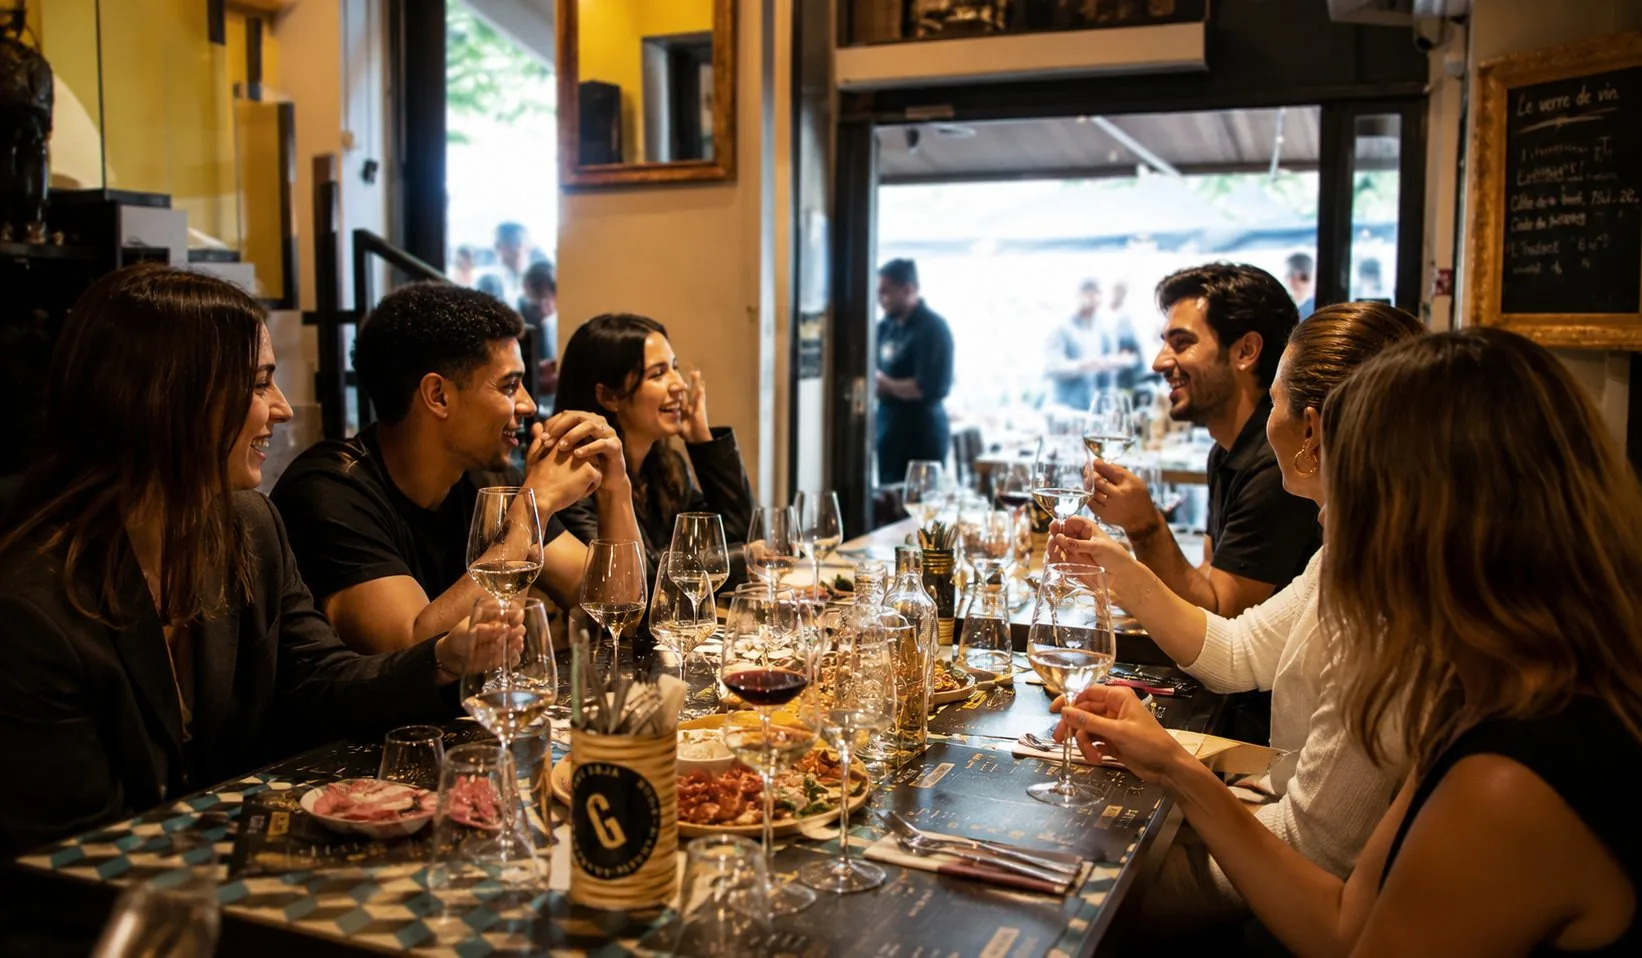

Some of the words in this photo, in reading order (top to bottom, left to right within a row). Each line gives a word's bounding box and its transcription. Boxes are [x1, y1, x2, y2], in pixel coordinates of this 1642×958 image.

[1516, 91, 1534, 117] Le
[1539, 95, 1571, 112] verre
[1576, 83, 1592, 106] de
[1598, 81, 1619, 102] vin
[587, 793, 626, 848] G
